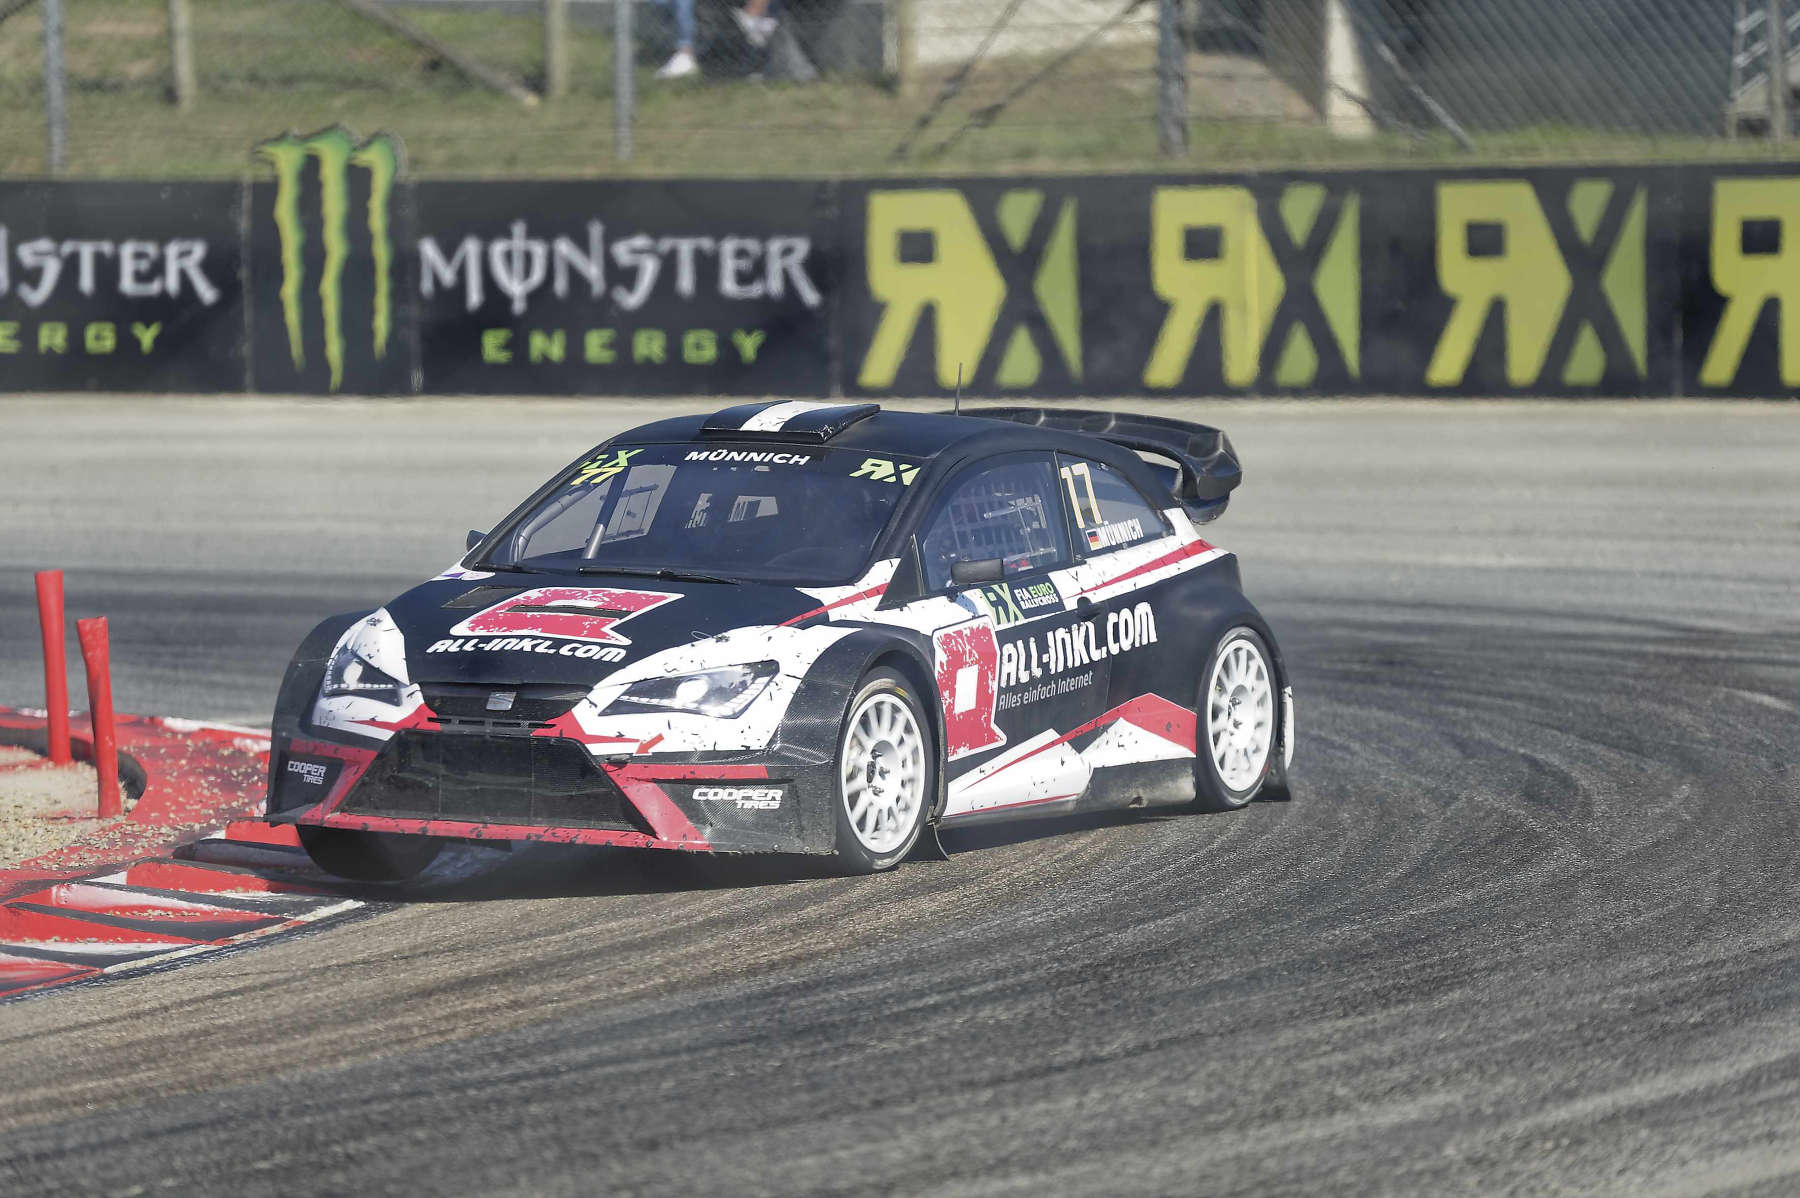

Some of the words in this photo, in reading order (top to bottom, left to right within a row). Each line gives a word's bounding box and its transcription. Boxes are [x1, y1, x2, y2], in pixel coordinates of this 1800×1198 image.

[418, 218, 822, 315] MONSTER
[480, 328, 766, 365] ENERGY
[684, 448, 811, 465] MÜNNICH
[1060, 462, 1103, 529] 17
[1013, 588, 1033, 602] FIA
[1028, 582, 1055, 598] EURO
[1019, 593, 1059, 610] RALLYCROSS
[426, 638, 627, 663] ALL-INKL.COM
[1000, 601, 1158, 688] ALL-INKL.COM
[998, 692, 1022, 711] Alles
[1023, 681, 1057, 705] einfach
[1057, 670, 1094, 694] Internet
[287, 760, 326, 777] COOPER
[303, 774, 323, 785] TIRES
[692, 788, 784, 801] COOPER
[735, 800, 781, 809] TIRES
